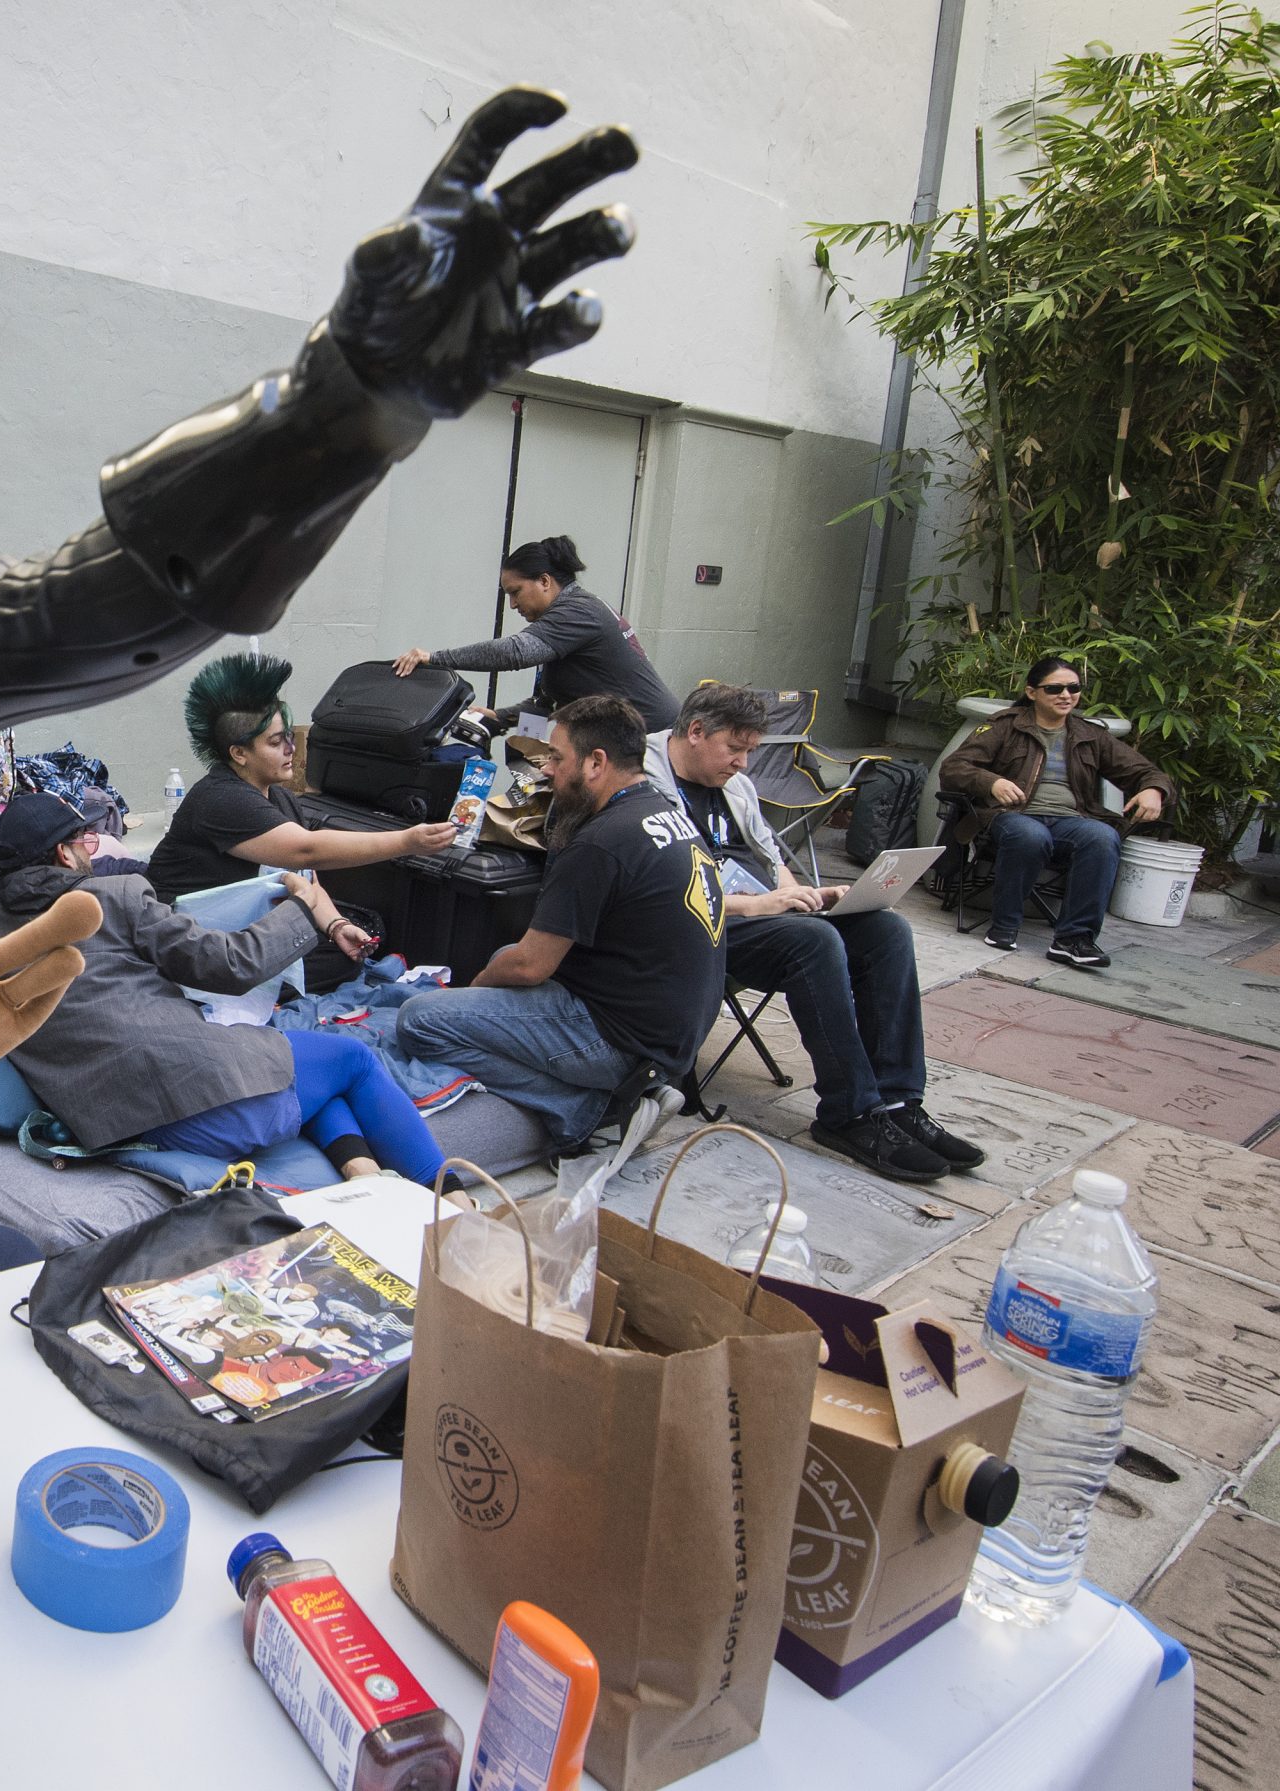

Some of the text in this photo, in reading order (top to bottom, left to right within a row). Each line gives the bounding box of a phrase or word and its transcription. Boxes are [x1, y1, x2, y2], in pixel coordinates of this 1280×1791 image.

[379, 1272, 418, 1305] WA
[1006, 1306, 1060, 1340] SPRING
[899, 1364, 928, 1383] Caution
[903, 1375, 941, 1399] Hot Liquid
[726, 1386, 741, 1442] LEAF
[821, 1394, 882, 1416] LEAF
[464, 1418, 501, 1461] BEAN
[730, 1450, 743, 1496] TEA
[450, 1489, 506, 1522] TEA LEAF
[806, 1459, 858, 1522] EAN
[733, 1518, 747, 1583] BEAN
[794, 1581, 852, 1615] LEAF
[723, 1589, 748, 1665] COFFEE
